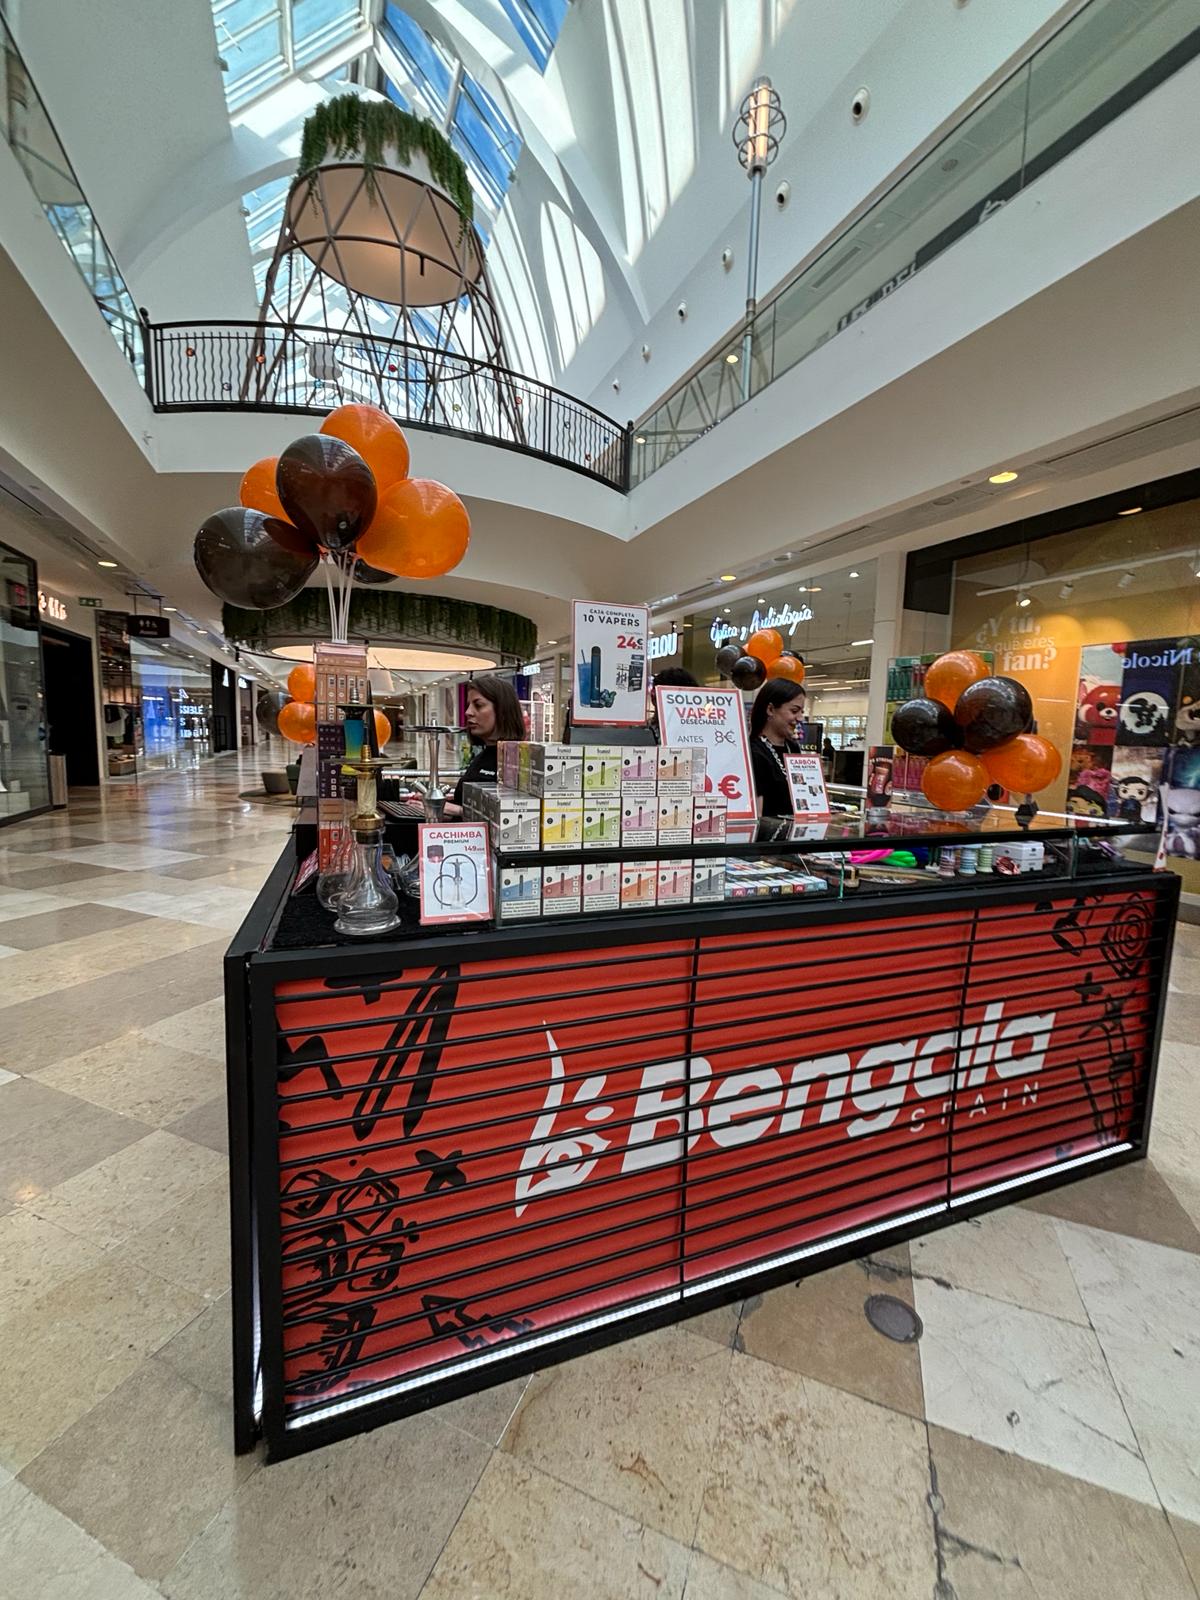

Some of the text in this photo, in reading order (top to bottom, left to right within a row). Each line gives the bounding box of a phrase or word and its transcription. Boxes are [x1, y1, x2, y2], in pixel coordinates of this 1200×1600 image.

[583, 614, 640, 627] 10 VAPERS
[647, 633, 678, 660] ELOU
[1003, 647, 1057, 672] fan?
[666, 694, 733, 706] SOLO HOY
[675, 706, 727, 719] VAPER
[677, 729, 736, 745] ANTES 8€
[429, 831, 482, 839] CACHIMBA
[620, 1001, 1056, 1174] Bengala
[909, 1081, 1039, 1133] SPAIN
